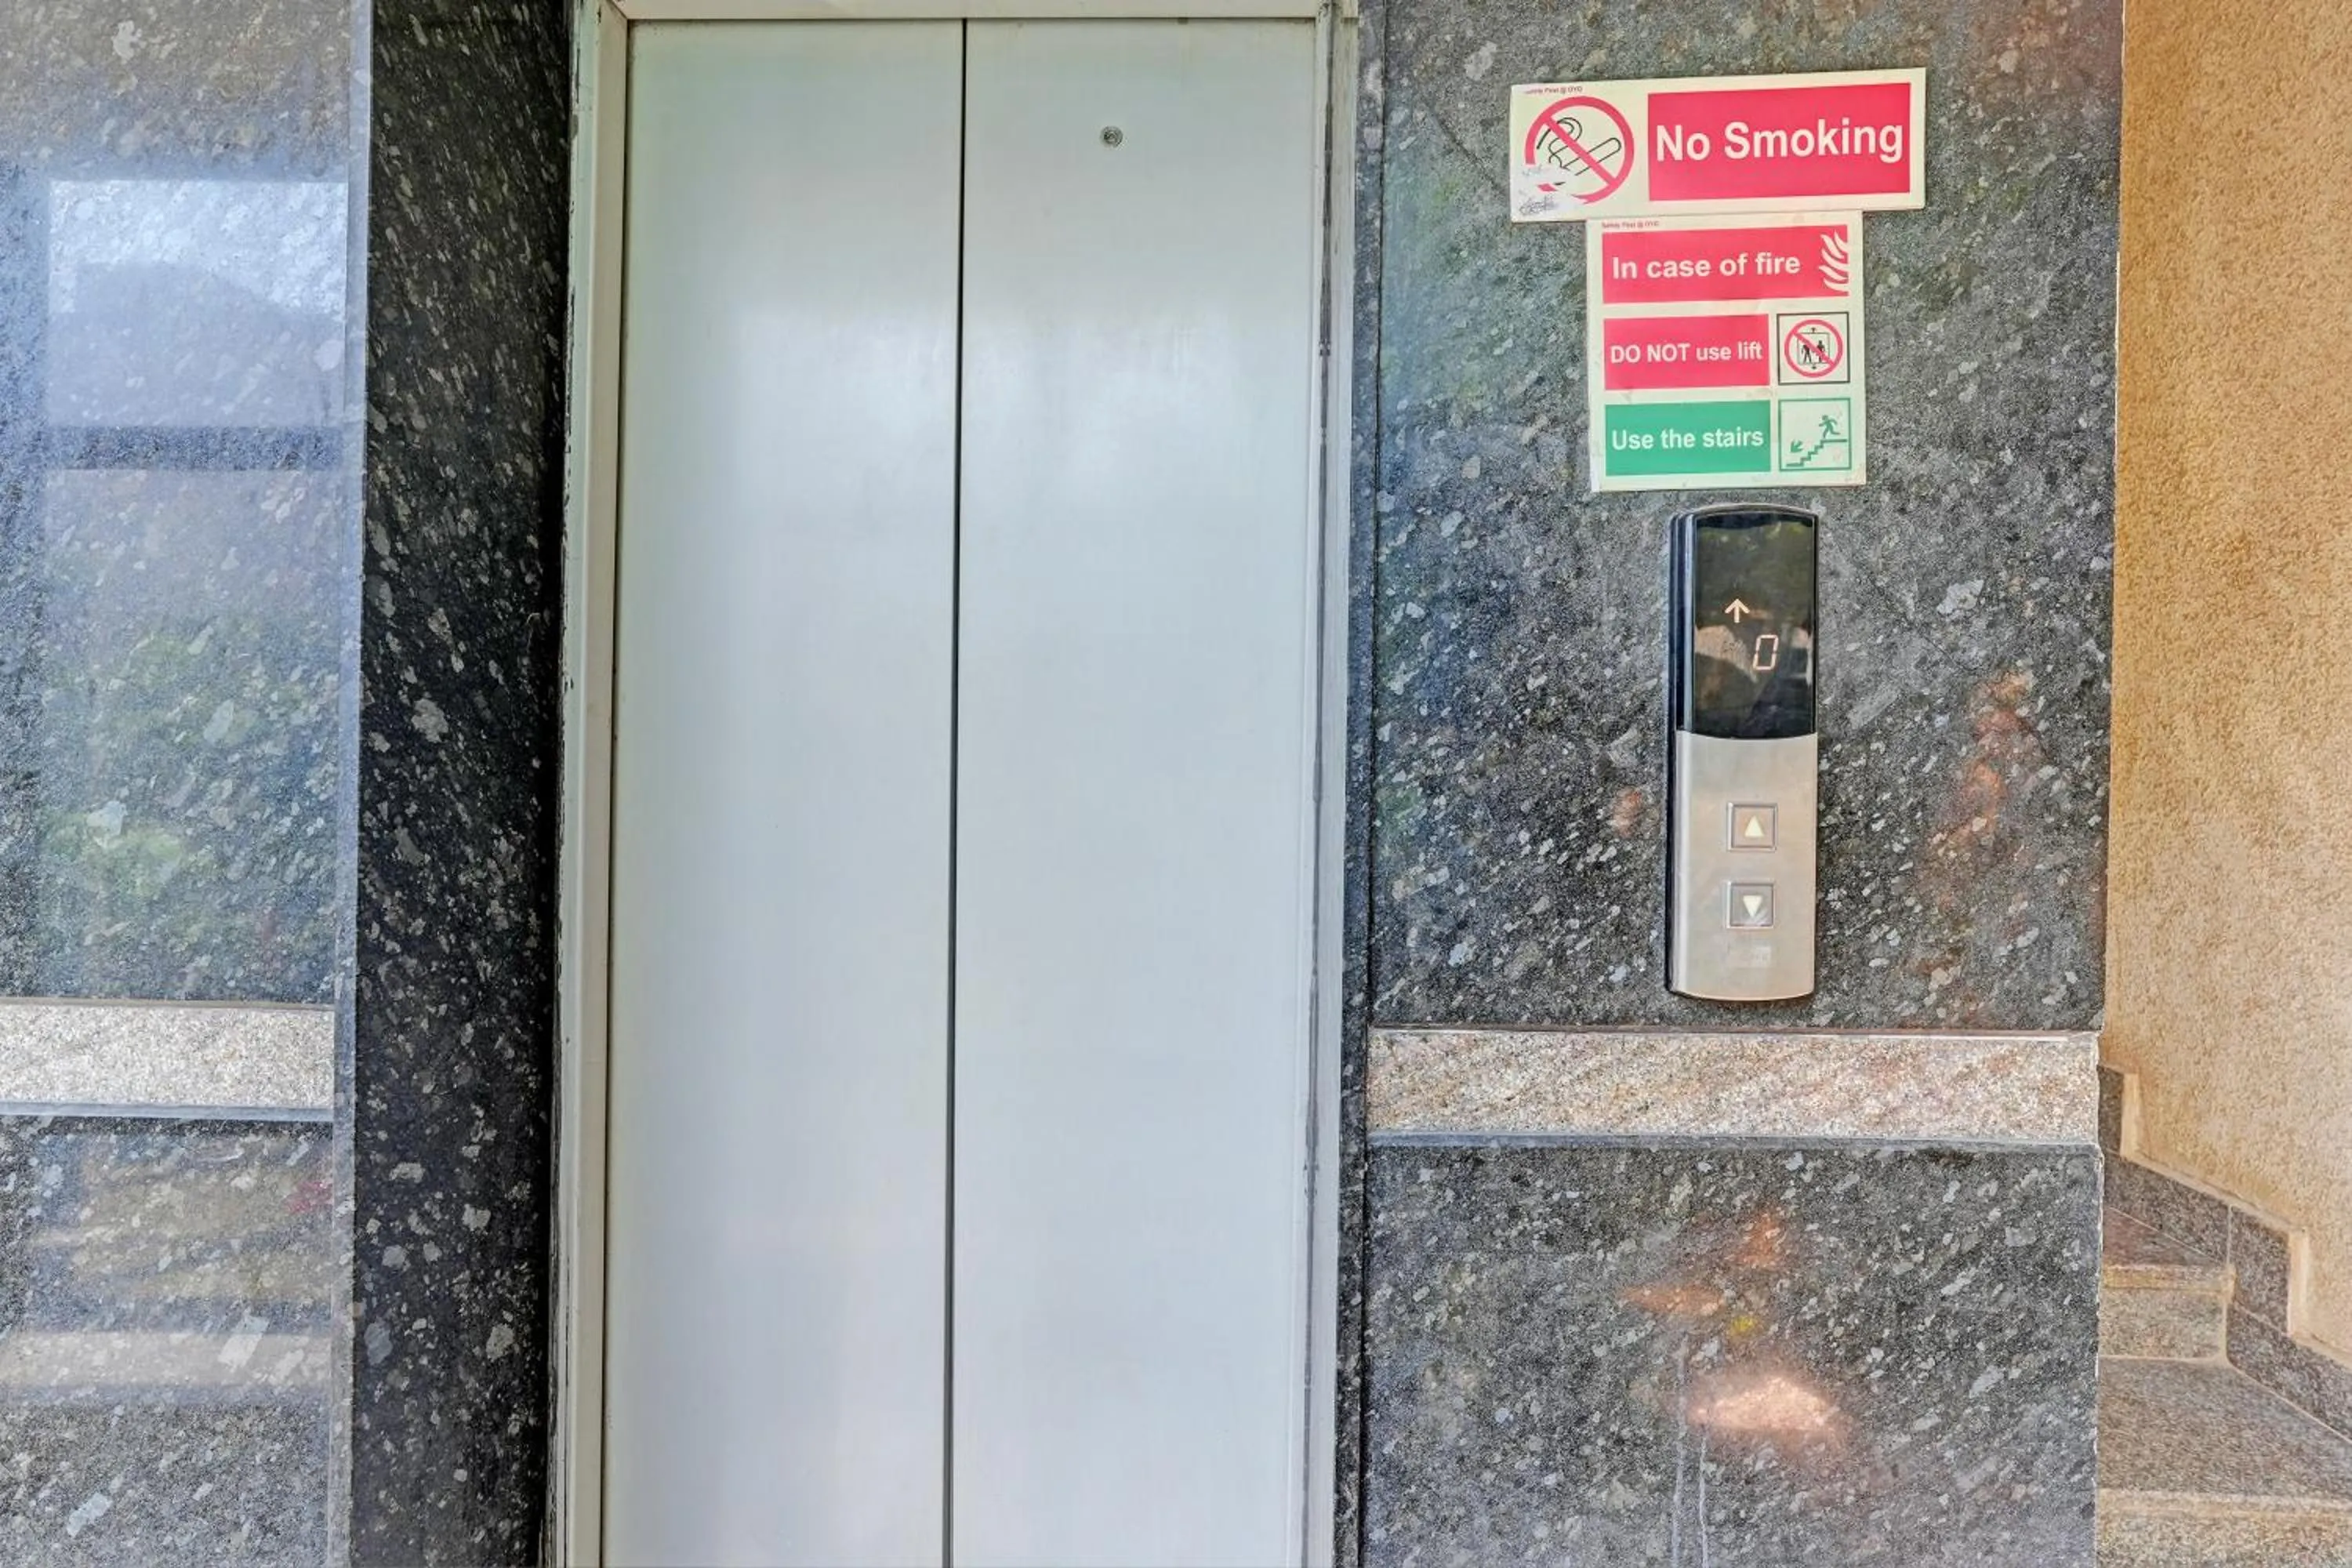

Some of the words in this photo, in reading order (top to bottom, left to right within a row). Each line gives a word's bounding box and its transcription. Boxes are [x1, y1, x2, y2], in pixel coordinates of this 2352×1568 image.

[1656, 124, 1711, 161] No
[1724, 118, 1904, 164] Smoking
[1611, 256, 1638, 279] In
[1646, 257, 1711, 278] case
[1719, 252, 1749, 276] of
[1755, 252, 1801, 274] fire
[1610, 344, 1641, 363] DO
[1647, 343, 1690, 361] NOT
[1696, 346, 1732, 361] use
[1737, 341, 1763, 360] lift
[1611, 429, 1656, 451] Use
[1660, 428, 1697, 448] the
[1702, 426, 1764, 448] stairs
[1752, 633, 1780, 671] 0
